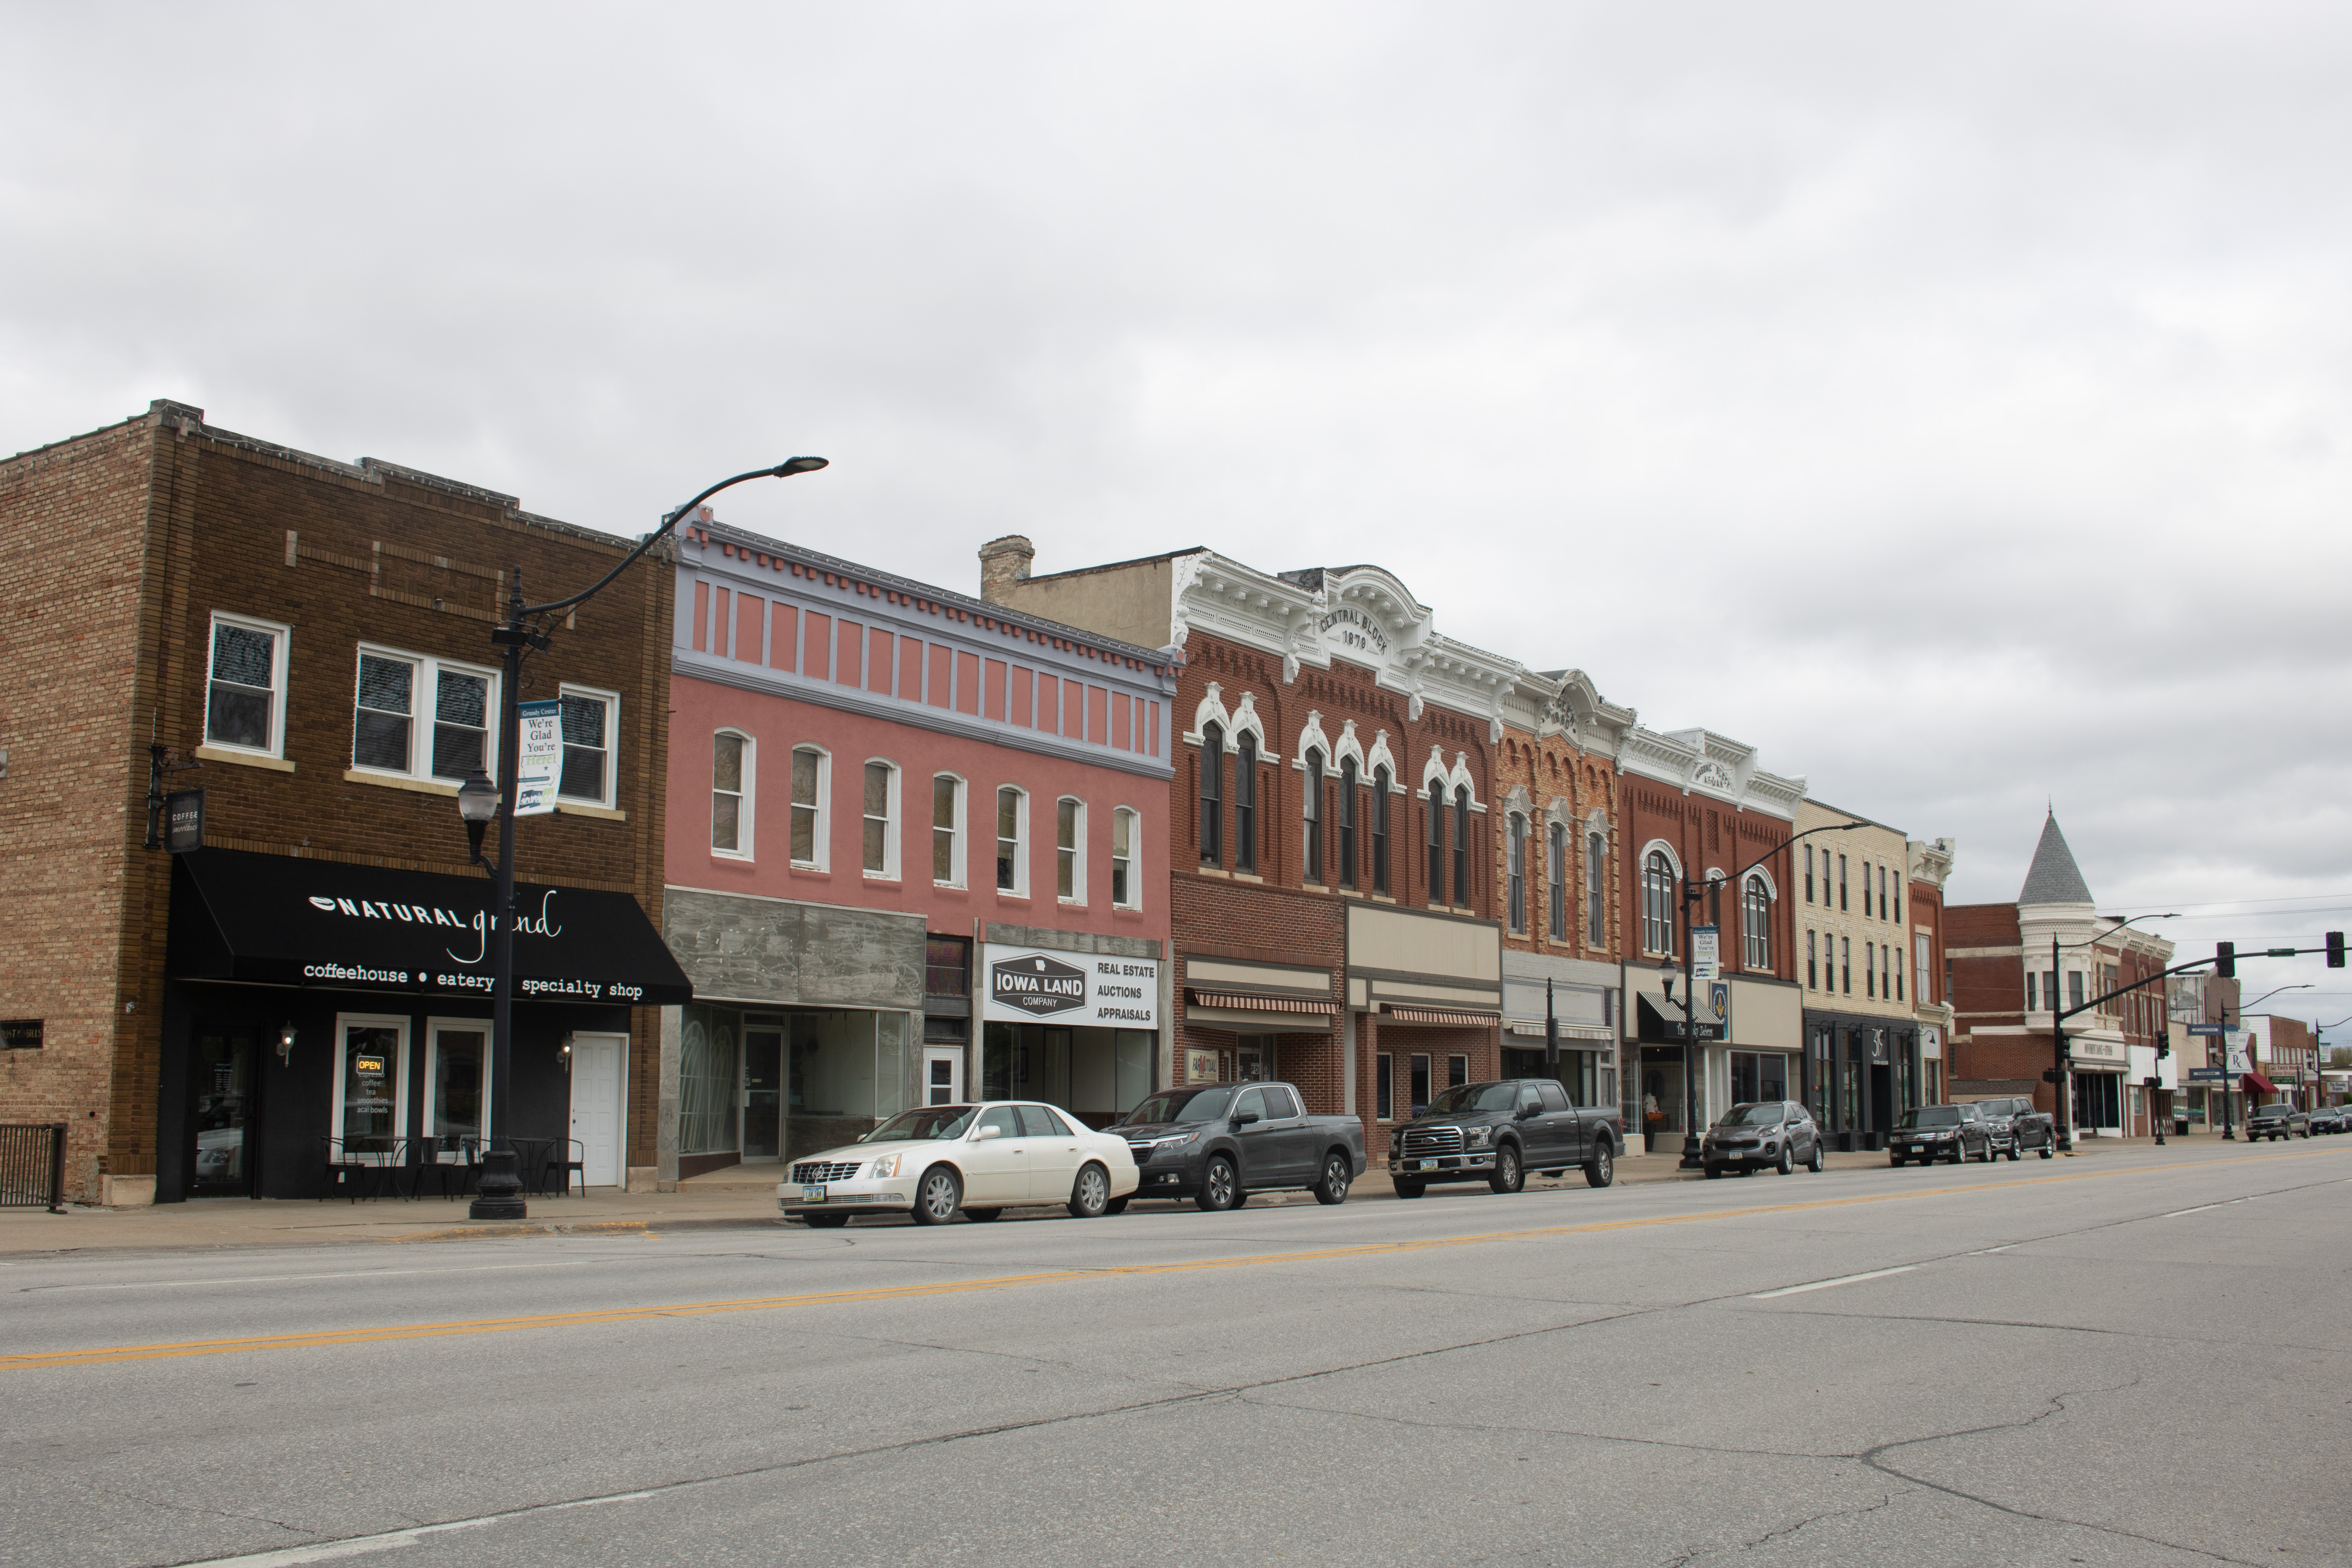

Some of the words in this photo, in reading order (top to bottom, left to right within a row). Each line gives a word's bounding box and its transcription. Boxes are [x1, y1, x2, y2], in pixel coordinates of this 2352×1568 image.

[1320, 609, 1359, 632] CENTRAL
[1362, 615, 1387, 655] BLOCK
[1344, 630, 1366, 649] 1879
[529, 719, 553, 728] We're
[1553, 712, 1570, 729] 1880
[531, 730, 552, 740] Glad
[528, 742, 555, 752] You're
[526, 752, 556, 765] Here!
[172, 811, 198, 821] COFFEE
[172, 820, 198, 833] smoothies
[336, 898, 467, 928] NATURAL
[446, 890, 561, 963] grnd
[1098, 962, 1120, 975] REAL
[1123, 964, 1154, 978] ESTATE
[304, 963, 408, 982] coffeehouse
[437, 973, 495, 992] eatery
[522, 979, 601, 998] specialty
[610, 983, 642, 1000] shop
[997, 973, 1039, 991] IOWA
[1044, 979, 1082, 996] LAND
[1098, 985, 1142, 998] AUCTIONS
[1023, 997, 1057, 1007] COMPANY
[1098, 1007, 1151, 1020] APPRAISALS
[25, 1029, 42, 1038] BILLS
[1677, 1023, 1685, 1035] The
[359, 1061, 381, 1070] OPEN
